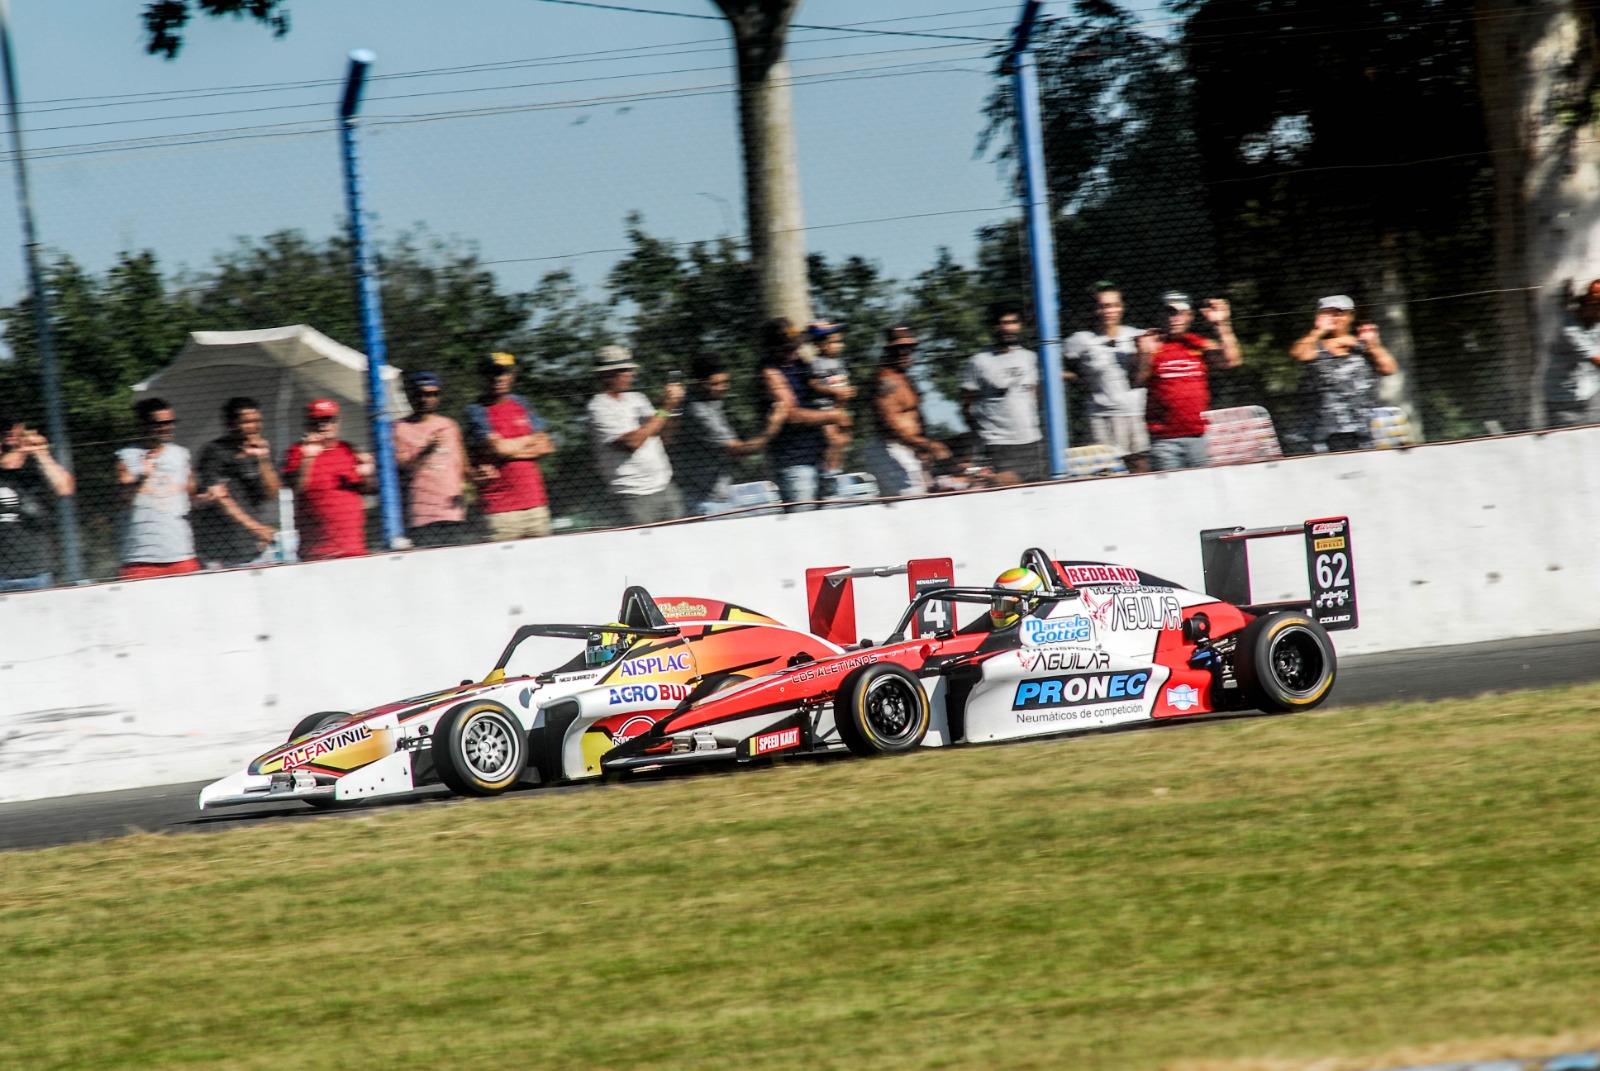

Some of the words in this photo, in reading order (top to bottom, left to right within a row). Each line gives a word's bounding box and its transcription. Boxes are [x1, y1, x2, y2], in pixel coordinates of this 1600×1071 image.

[1316, 538, 1343, 549] PIRELLI
[1067, 567, 1138, 583] REDBAND
[1316, 552, 1350, 589] 62
[1090, 586, 1174, 595] TRANSPORTE
[923, 598, 947, 629] 4
[1025, 615, 1089, 632] Marcelo
[1112, 595, 1183, 631] AGUILAR
[621, 653, 690, 677] AISPLAC
[791, 670, 815, 684] LOS
[817, 653, 879, 678] ALETIANOS
[1030, 652, 1110, 672] AGUILAR
[1015, 673, 1148, 706] PRONEC
[1016, 711, 1078, 723] Neumáticos
[1080, 709, 1092, 719] de
[1094, 704, 1143, 719] competición
[282, 726, 371, 769] ALFAVINIL
[759, 734, 779, 751] SPEED
[779, 730, 798, 747] KART
